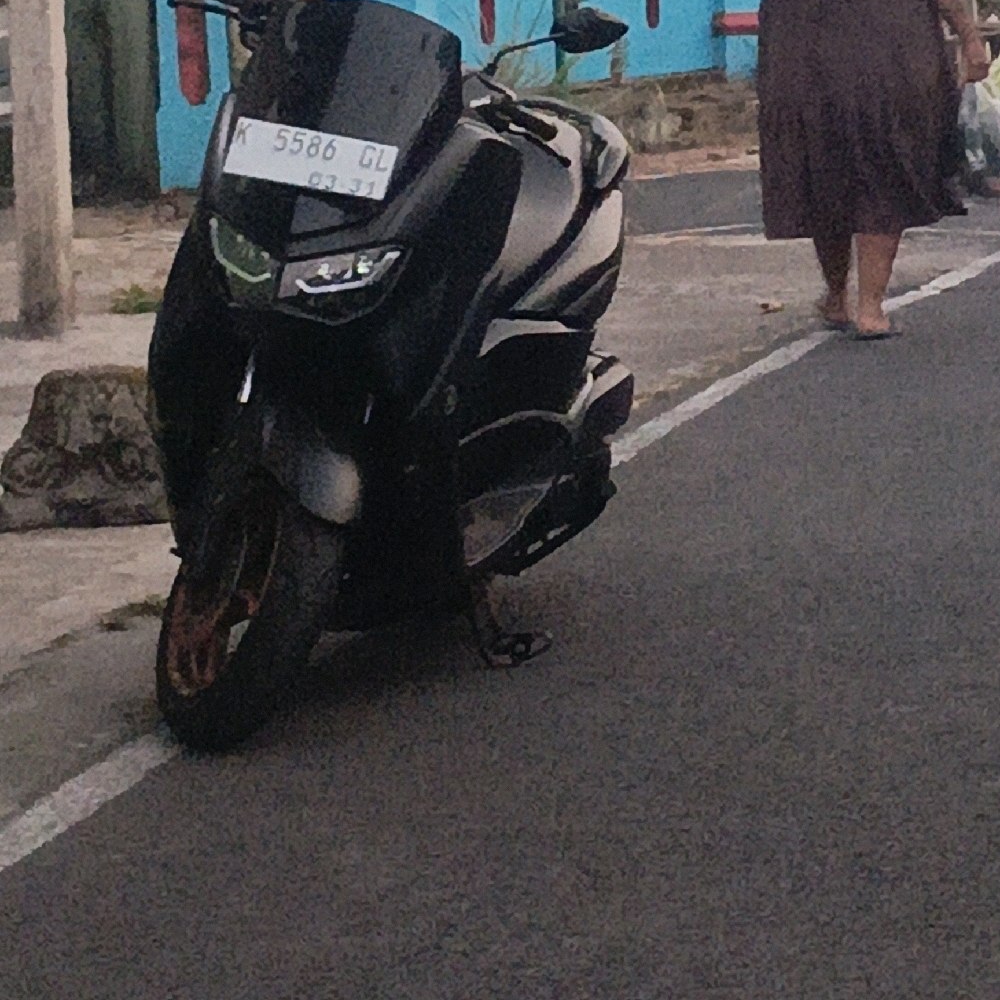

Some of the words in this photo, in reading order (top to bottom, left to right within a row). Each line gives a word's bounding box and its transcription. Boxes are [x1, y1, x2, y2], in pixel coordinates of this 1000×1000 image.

[235, 121, 252, 146] K
[272, 128, 338, 161] 5586
[358, 144, 389, 172] GL
